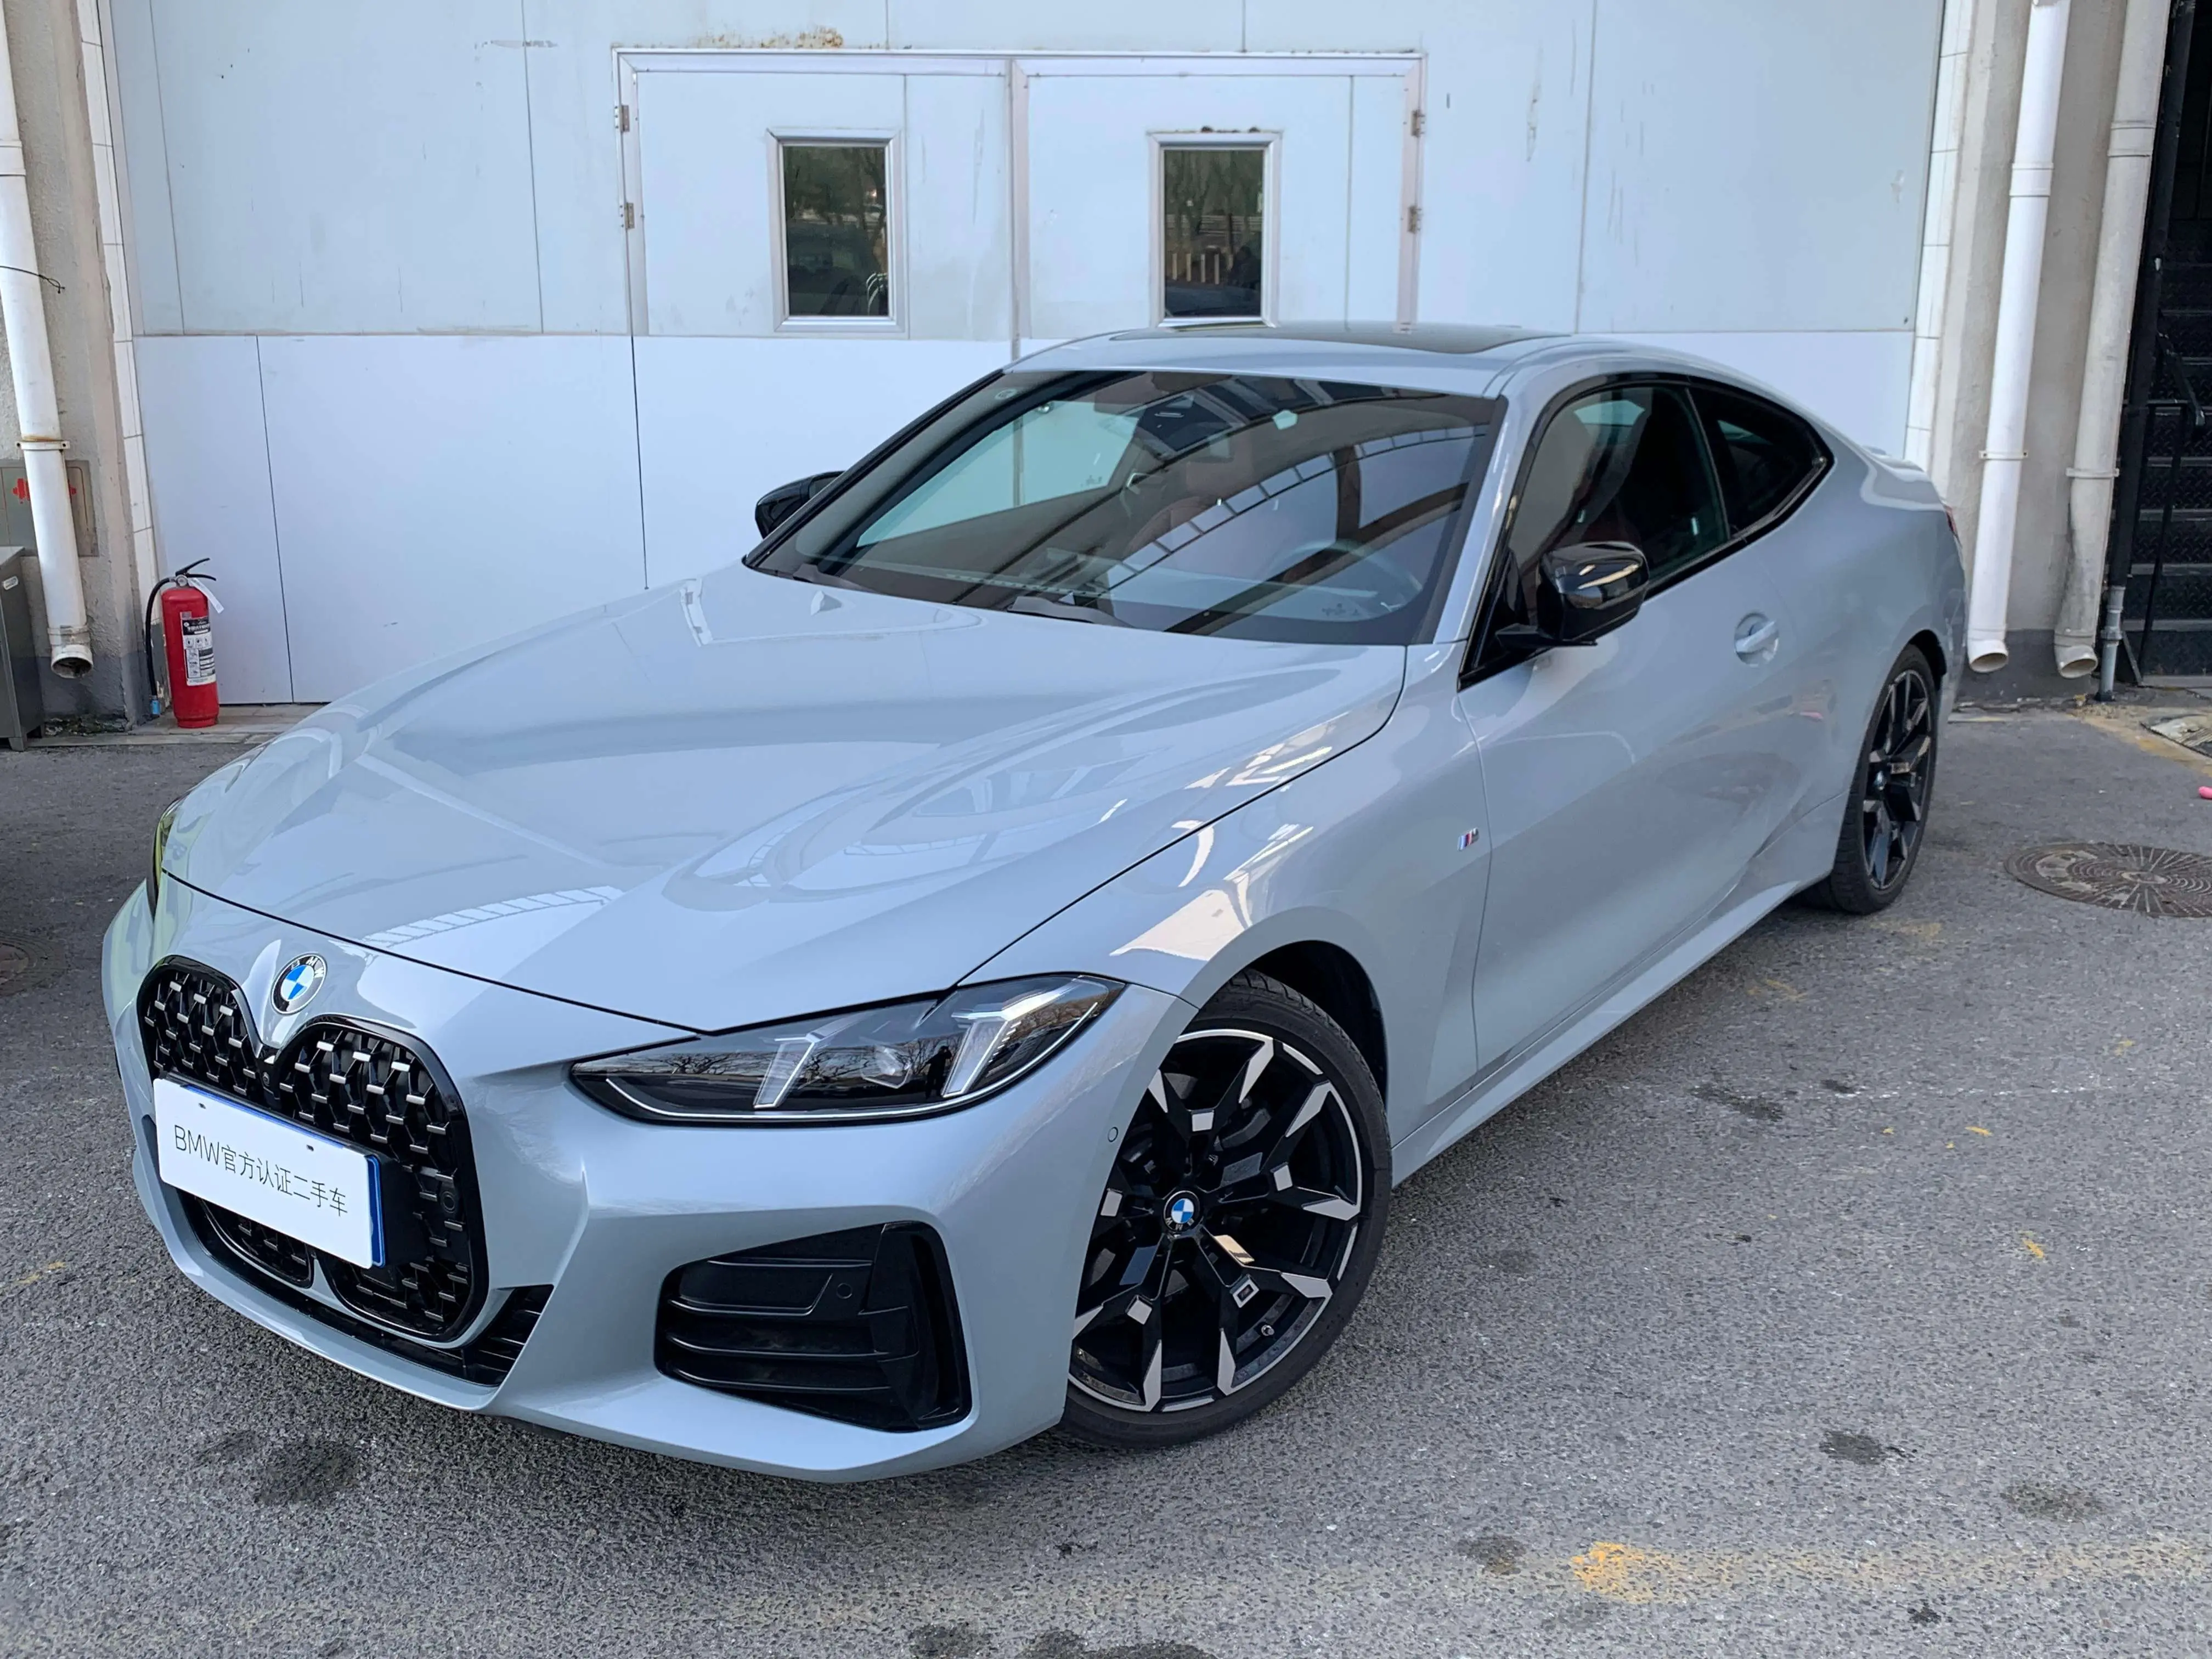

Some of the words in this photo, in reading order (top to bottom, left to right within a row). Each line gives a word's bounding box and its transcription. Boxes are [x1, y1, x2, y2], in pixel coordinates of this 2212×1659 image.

[174, 1124, 348, 1217] BMW官方认证二手车
